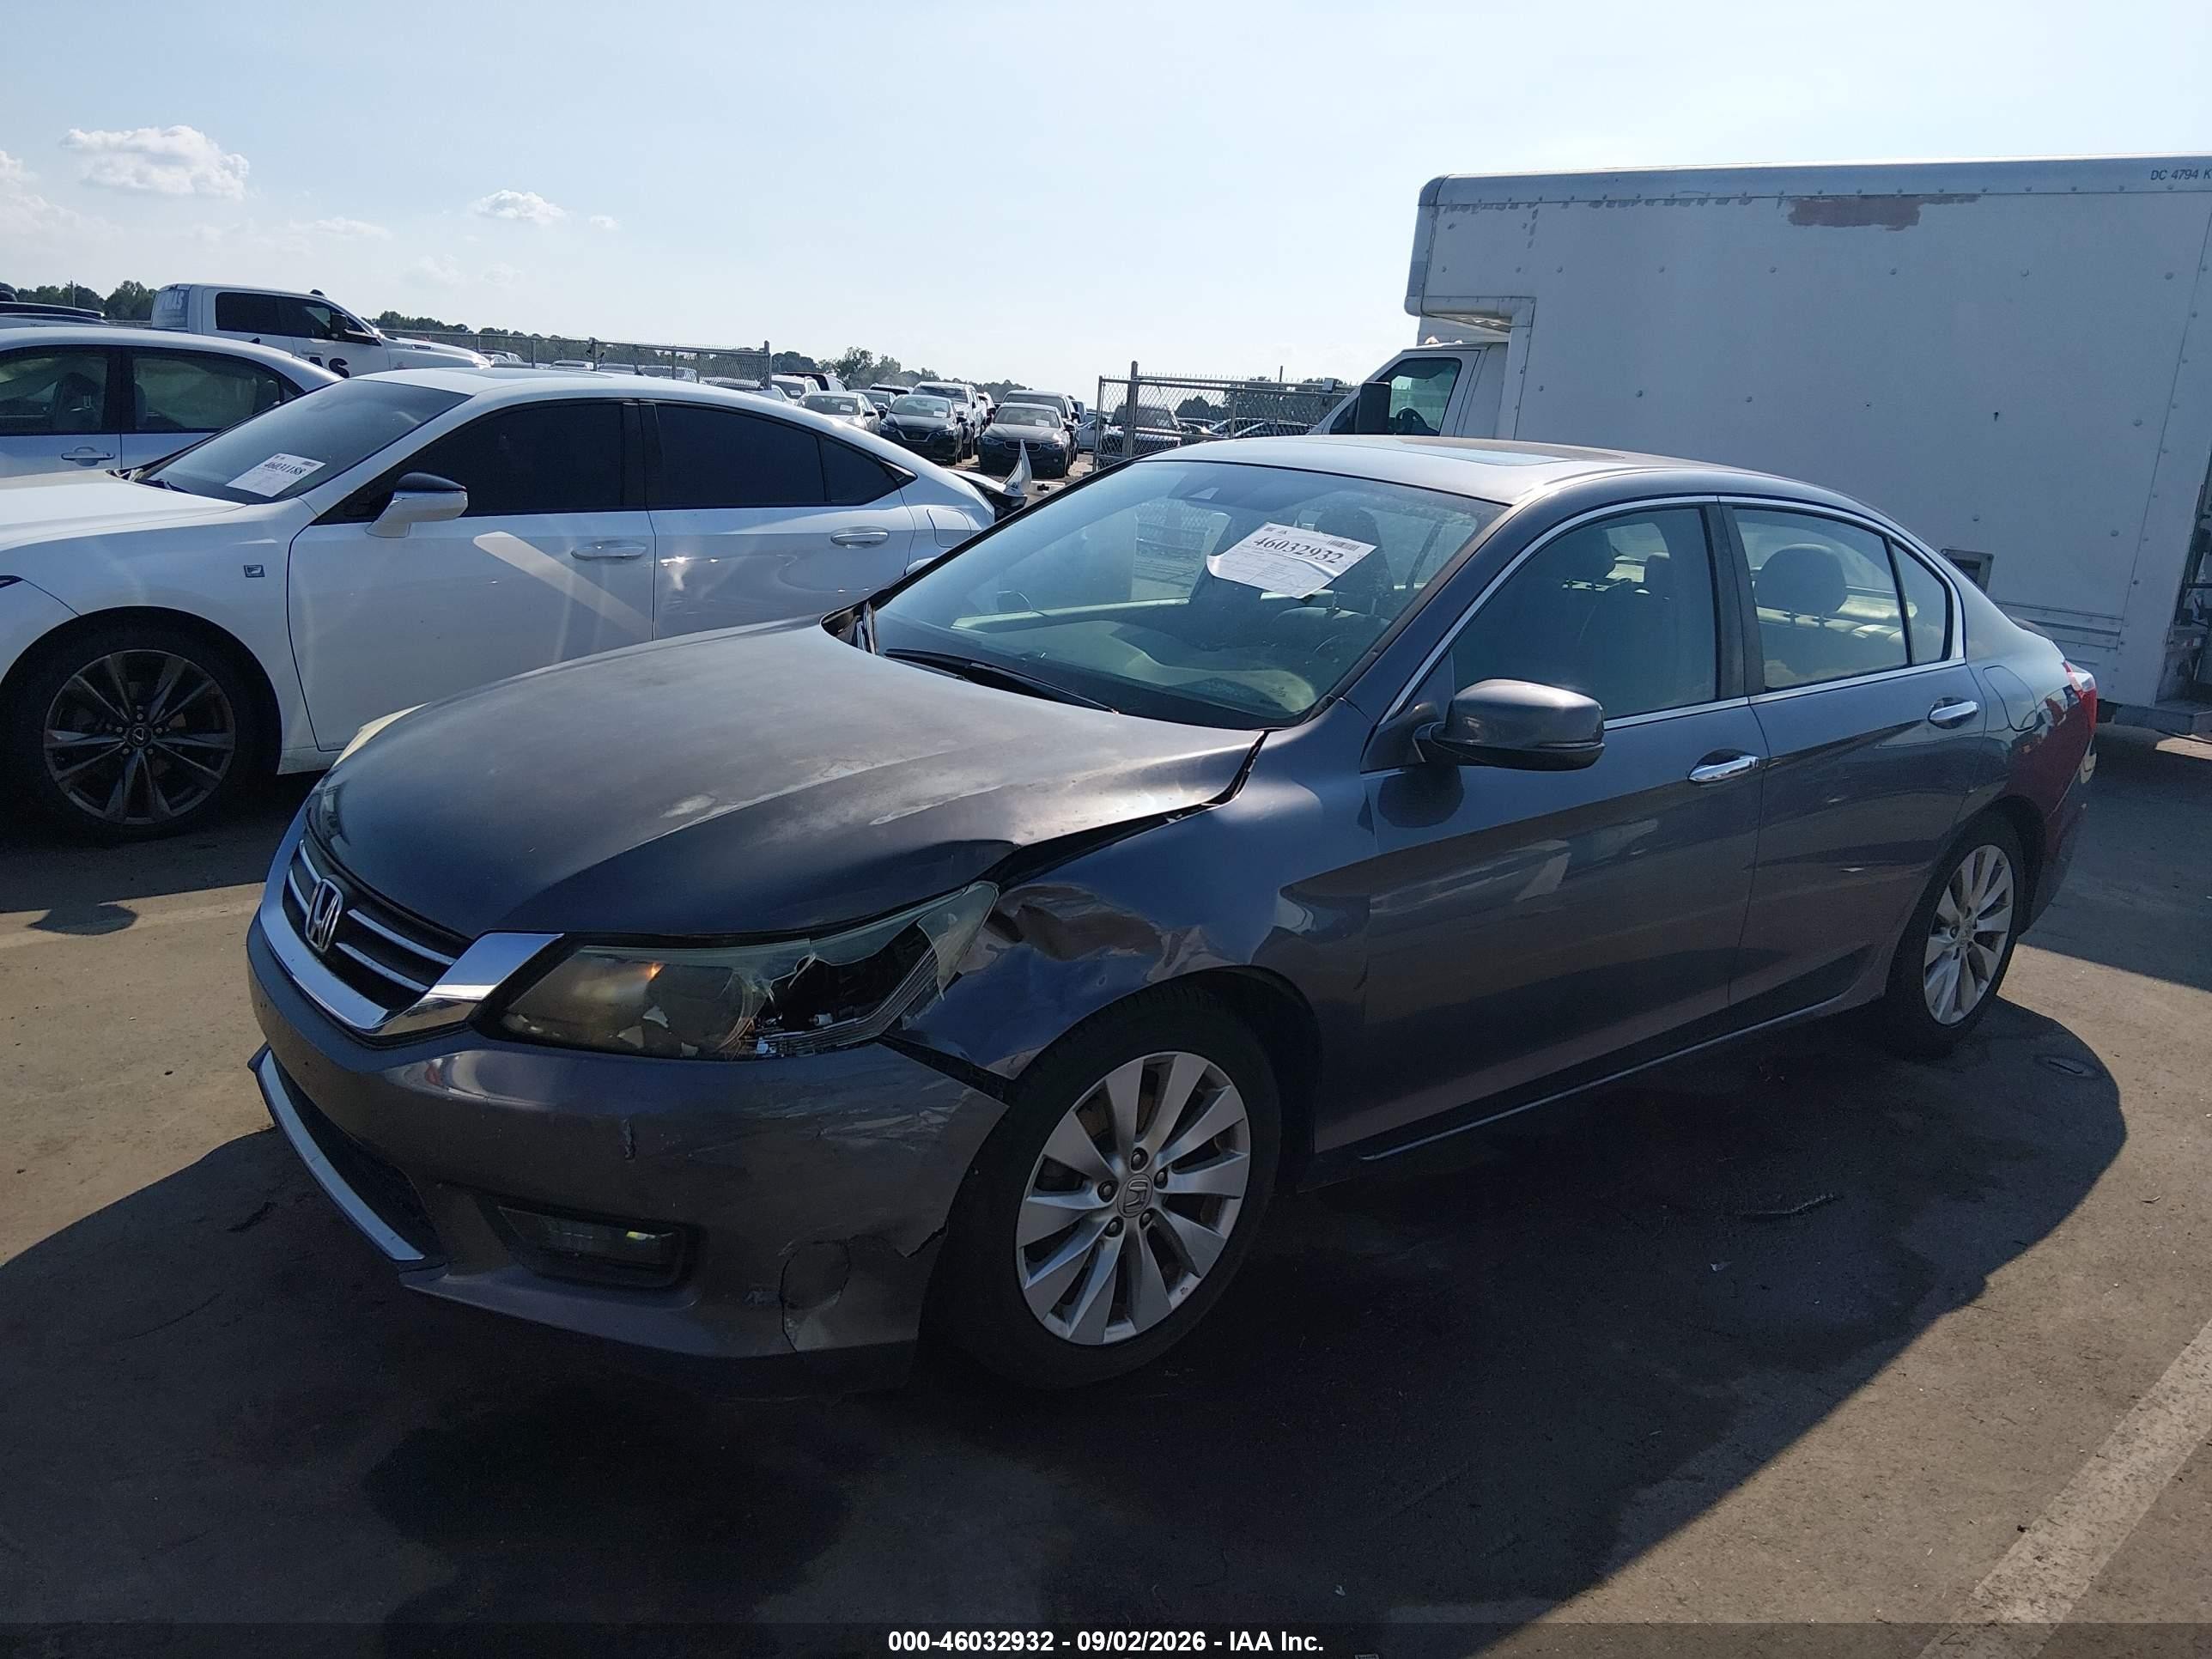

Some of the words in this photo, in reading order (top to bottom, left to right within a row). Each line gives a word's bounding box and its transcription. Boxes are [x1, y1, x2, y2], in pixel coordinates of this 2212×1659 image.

[2150, 169, 2168, 180] DC
[2171, 168, 2198, 180] 4794
[1254, 536, 1345, 564] 46032932
